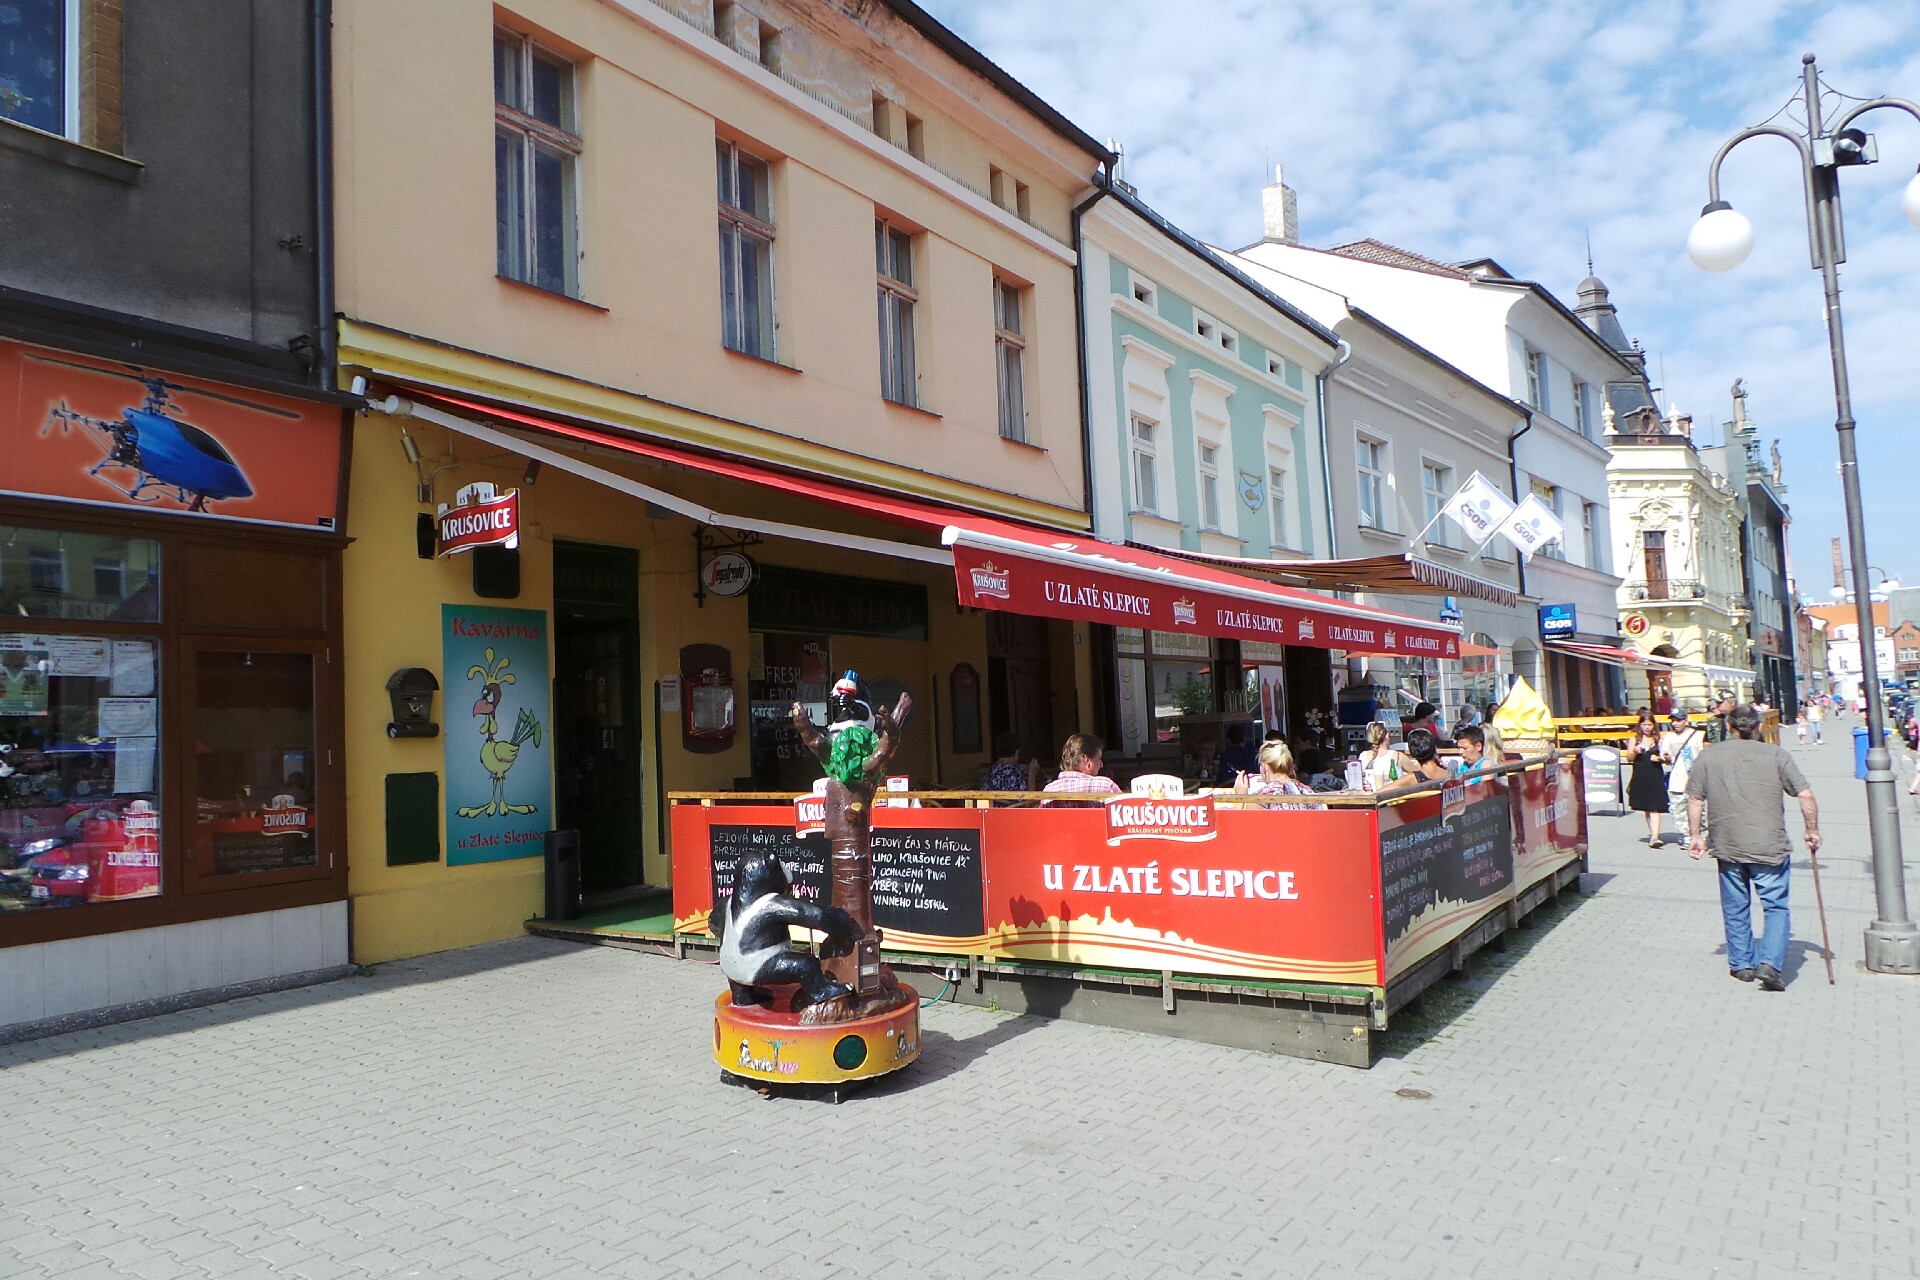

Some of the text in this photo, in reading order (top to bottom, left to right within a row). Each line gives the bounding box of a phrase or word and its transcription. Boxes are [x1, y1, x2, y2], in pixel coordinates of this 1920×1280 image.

[459, 491, 491, 505] 15 81
[441, 506, 512, 542] KRUŠOVICE
[708, 560, 745, 588] Segafredo
[972, 572, 1008, 592] KRUŠOVICE
[1044, 580, 1151, 616] U ZLATÉ SLEPICE
[452, 617, 540, 640] Kavárna
[1217, 609, 1284, 634] U ZLATÉ SLEPICE
[1328, 625, 1333, 639] U
[1333, 624, 1353, 642] ZLATÉ
[1353, 630, 1375, 644] SLEPICE
[765, 666, 802, 684] FRESH
[1135, 784, 1178, 793] 15 81
[1111, 801, 1209, 829] KRUŠOVICE
[714, 828, 793, 845] LEDOVÁ KÁVA SE
[1127, 826, 1192, 835] KRÁLOVSKÝ PIVOVAR
[457, 838, 466, 850] u
[468, 832, 500, 849] Zlaté
[904, 835, 921, 850] ČAJ
[925, 840, 931, 850] S
[714, 858, 741, 872] VELK
[899, 851, 952, 866] KRUŠOVICE
[925, 868, 947, 881] PIVA
[1043, 860, 1299, 901] U ZLATÉ SLEPICE
[791, 880, 820, 899] KÁVY
